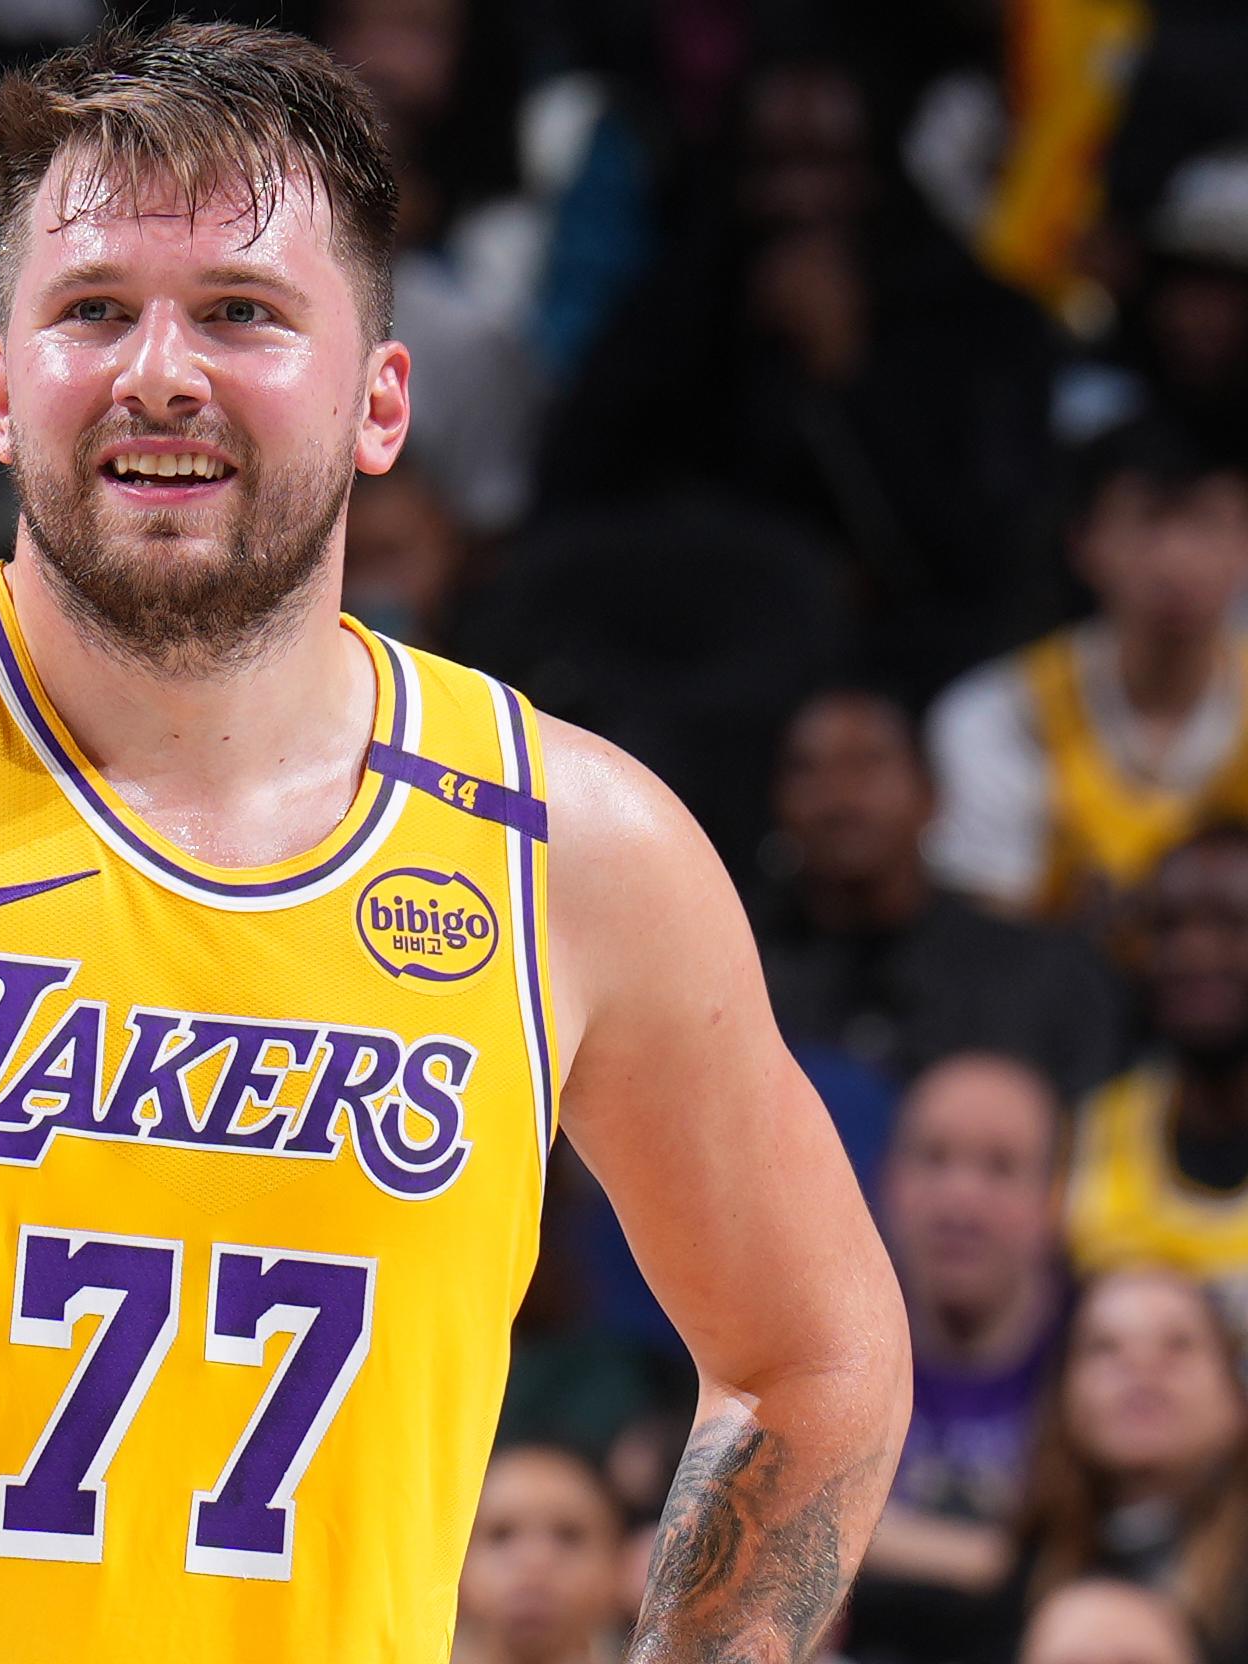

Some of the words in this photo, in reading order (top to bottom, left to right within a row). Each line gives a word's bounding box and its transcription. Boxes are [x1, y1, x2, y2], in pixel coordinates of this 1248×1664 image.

[438, 771, 479, 809] 44
[370, 896, 490, 949] bibigo
[393, 935, 443, 956] 비비고
